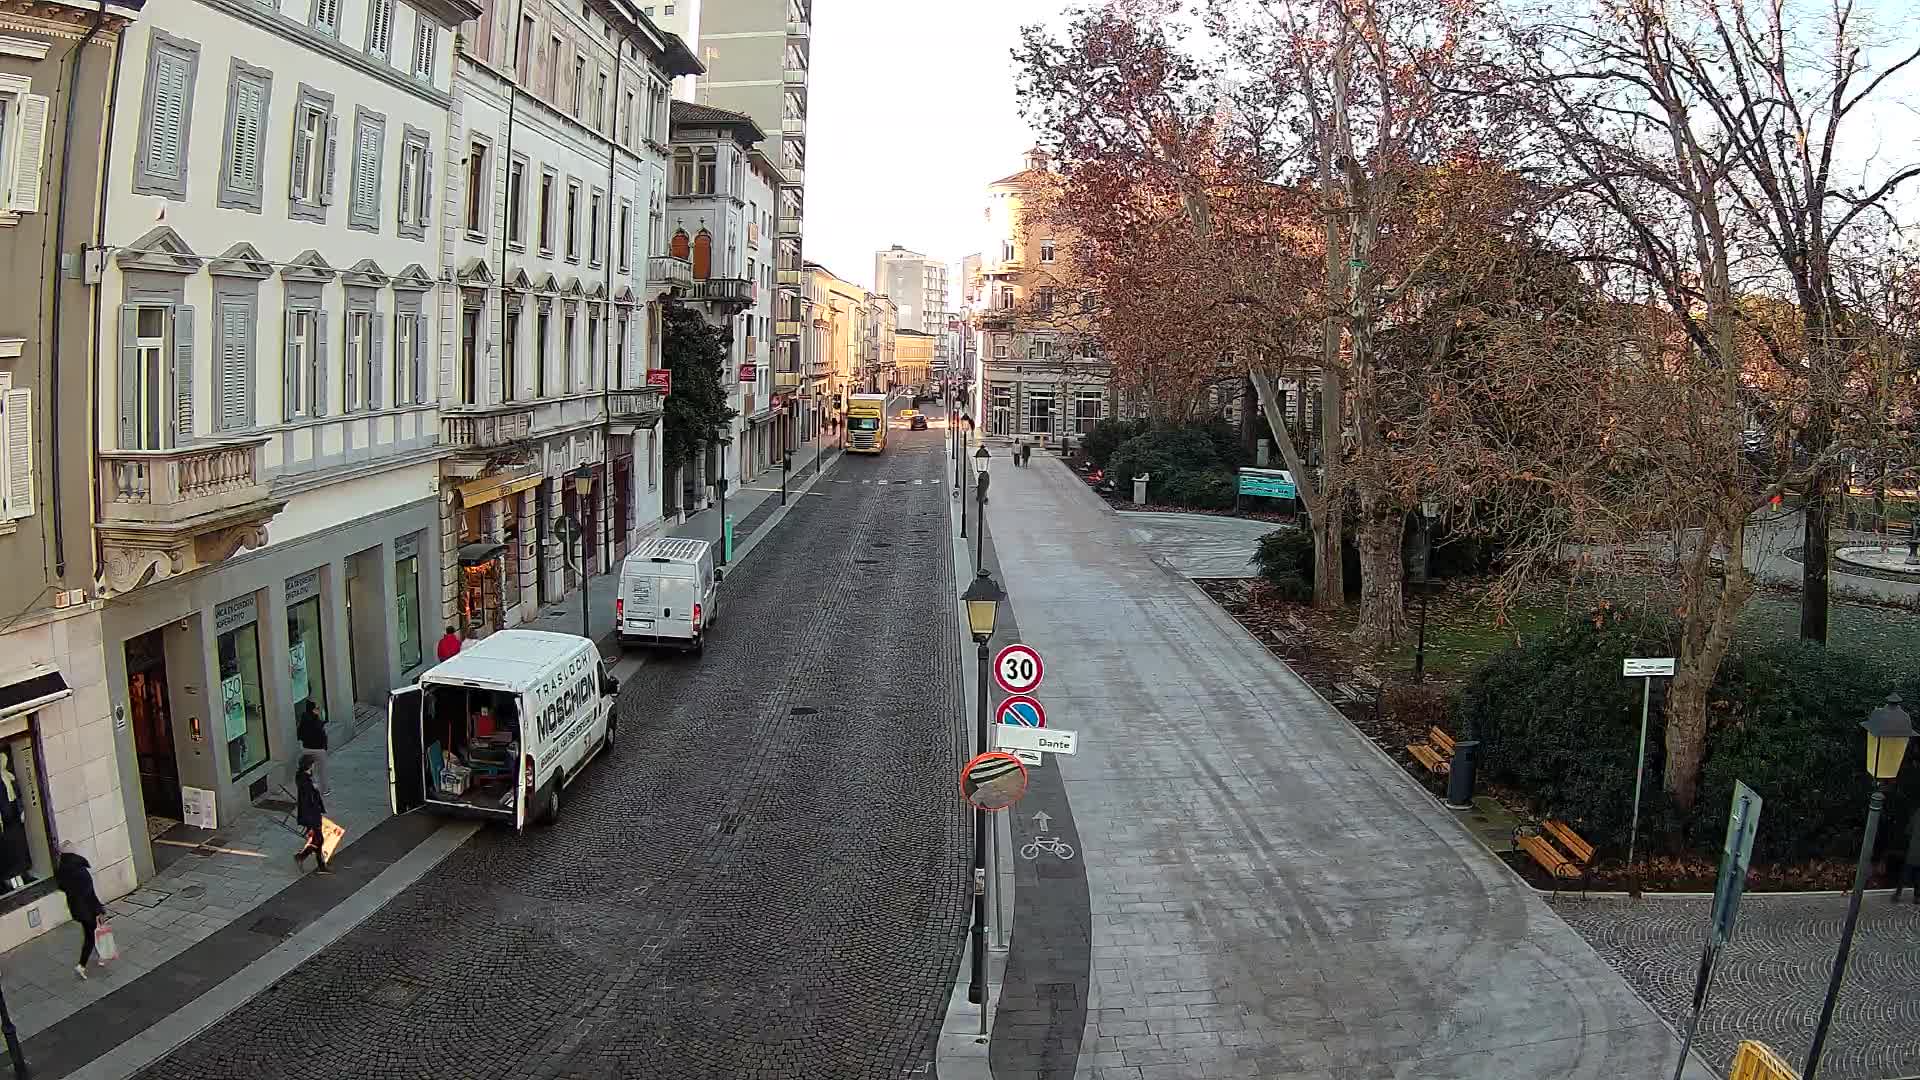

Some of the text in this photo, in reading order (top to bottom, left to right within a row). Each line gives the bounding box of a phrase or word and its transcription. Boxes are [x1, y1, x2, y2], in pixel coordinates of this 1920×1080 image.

[536, 651, 592, 701] TRASLOCHI
[1005, 658, 1034, 681] 30
[536, 671, 595, 743] MOSCHION
[1038, 738, 1071, 749] Dante
